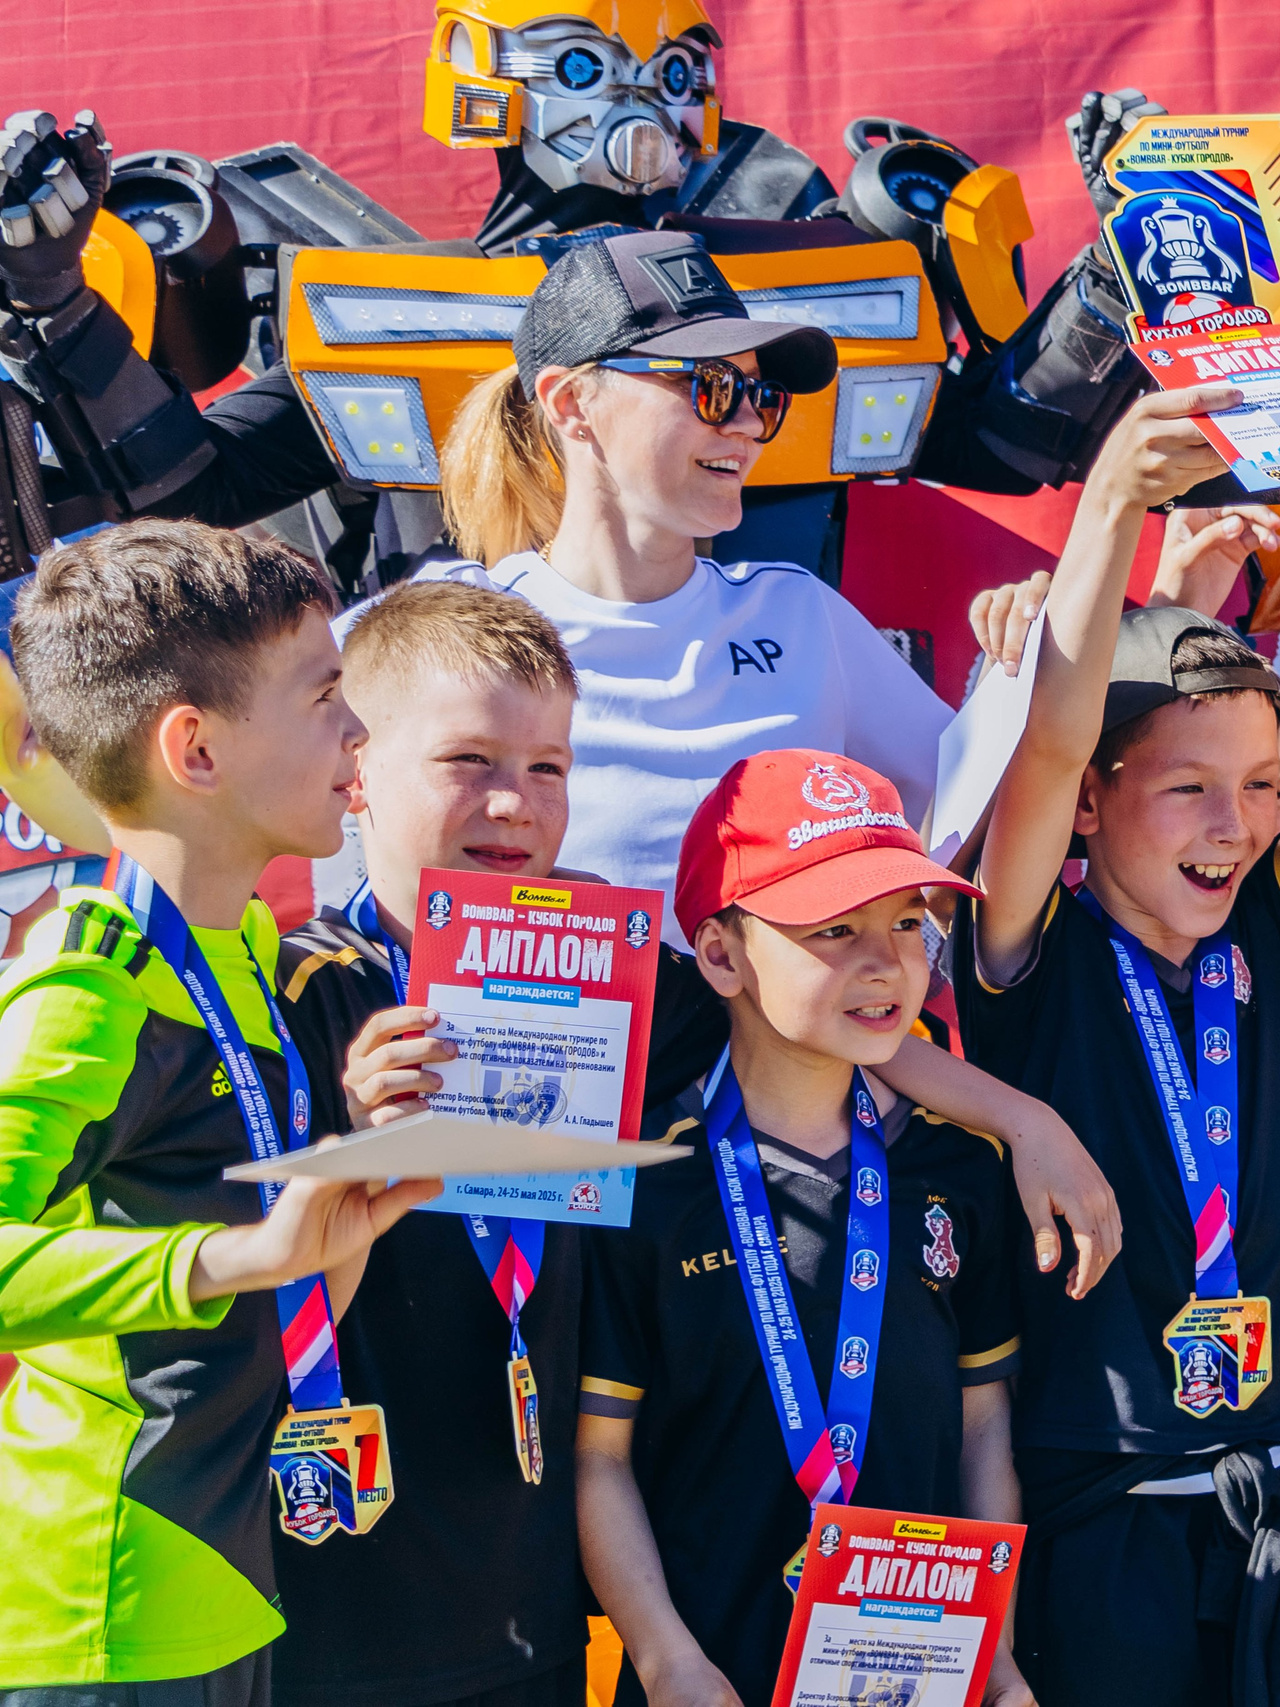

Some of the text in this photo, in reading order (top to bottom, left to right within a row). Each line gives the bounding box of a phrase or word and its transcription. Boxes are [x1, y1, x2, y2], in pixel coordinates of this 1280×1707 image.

[1151, 127, 1249, 139] МЕЖДУНАРОДНЫЙ ТУРНИР
[1140, 141, 1209, 151] ПО МИНИ-ФУТБОЛУ
[1171, 154, 1195, 163] КУБОК
[1155, 280, 1233, 295] BOMBBAR
[1196, 308, 1267, 333] ГОРОДОВ
[788, 807, 909, 850] Звениговский
[462, 904, 616, 932] BOMBBAR КУБОК ГОРОДОВ
[456, 927, 613, 983] ДИПЛОМ
[184, 969, 213, 1012] ГОРОДОВ»
[489, 984, 574, 1000] награждается:
[1144, 989, 1163, 1016] САМАРА
[206, 1011, 227, 1038] КУБОК
[446, 1022, 608, 1046] За место на Международном турнире по
[542, 1044, 564, 1054] КУБОК
[565, 1046, 599, 1058] ГОРОДОВ»
[1140, 1016, 1167, 1075] МИНИ-ФУТБОЛУ
[237, 1052, 258, 1087] САМАРА
[470, 1052, 512, 1064] спортивные
[513, 1057, 554, 1067] показатели
[566, 1062, 615, 1073] соревновании
[1158, 1073, 1171, 1085] ПО
[458, 1092, 504, 1105] Всероссийской
[1161, 1081, 1179, 1114] ТУРНИР
[458, 1106, 485, 1116] футбола
[564, 1115, 614, 1128] А. А. Гладышев
[239, 1089, 268, 1159] МИНИ-ФУТБОЛУ
[718, 1138, 738, 1176] ГОРОДОВ»
[1169, 1112, 1199, 1181] МЕЖДУНАРОДНЫЙ
[457, 1184, 563, 1202] г. Самара, 24-25 мая 2025 г.
[727, 1177, 744, 1202] КУБОК
[753, 1216, 772, 1246] САМАРА
[762, 1252, 779, 1278] ГОДА
[744, 1246, 771, 1313] МИНИ-ФУТБОЛУ
[768, 1276, 785, 1300] 2025
[760, 1312, 774, 1326] ПО
[773, 1298, 789, 1315] МАЯ
[763, 1324, 783, 1354] ТУРНИР
[778, 1314, 796, 1340] 24-25
[1242, 1369, 1268, 1384] МЕСТО
[770, 1355, 803, 1429] МЕЖДУНАРОДНЫЙ
[355, 1434, 379, 1491] 1
[357, 1487, 387, 1503] МЕСТО
[849, 1535, 982, 1561] BOMBBAR КУБОК ГОРОДОВ
[838, 1555, 977, 1602] ДИПЛОМ
[865, 1603, 938, 1618] награждается:
[849, 1638, 867, 1646] место
[876, 1639, 926, 1651] Международном
[928, 1644, 952, 1654] турнире
